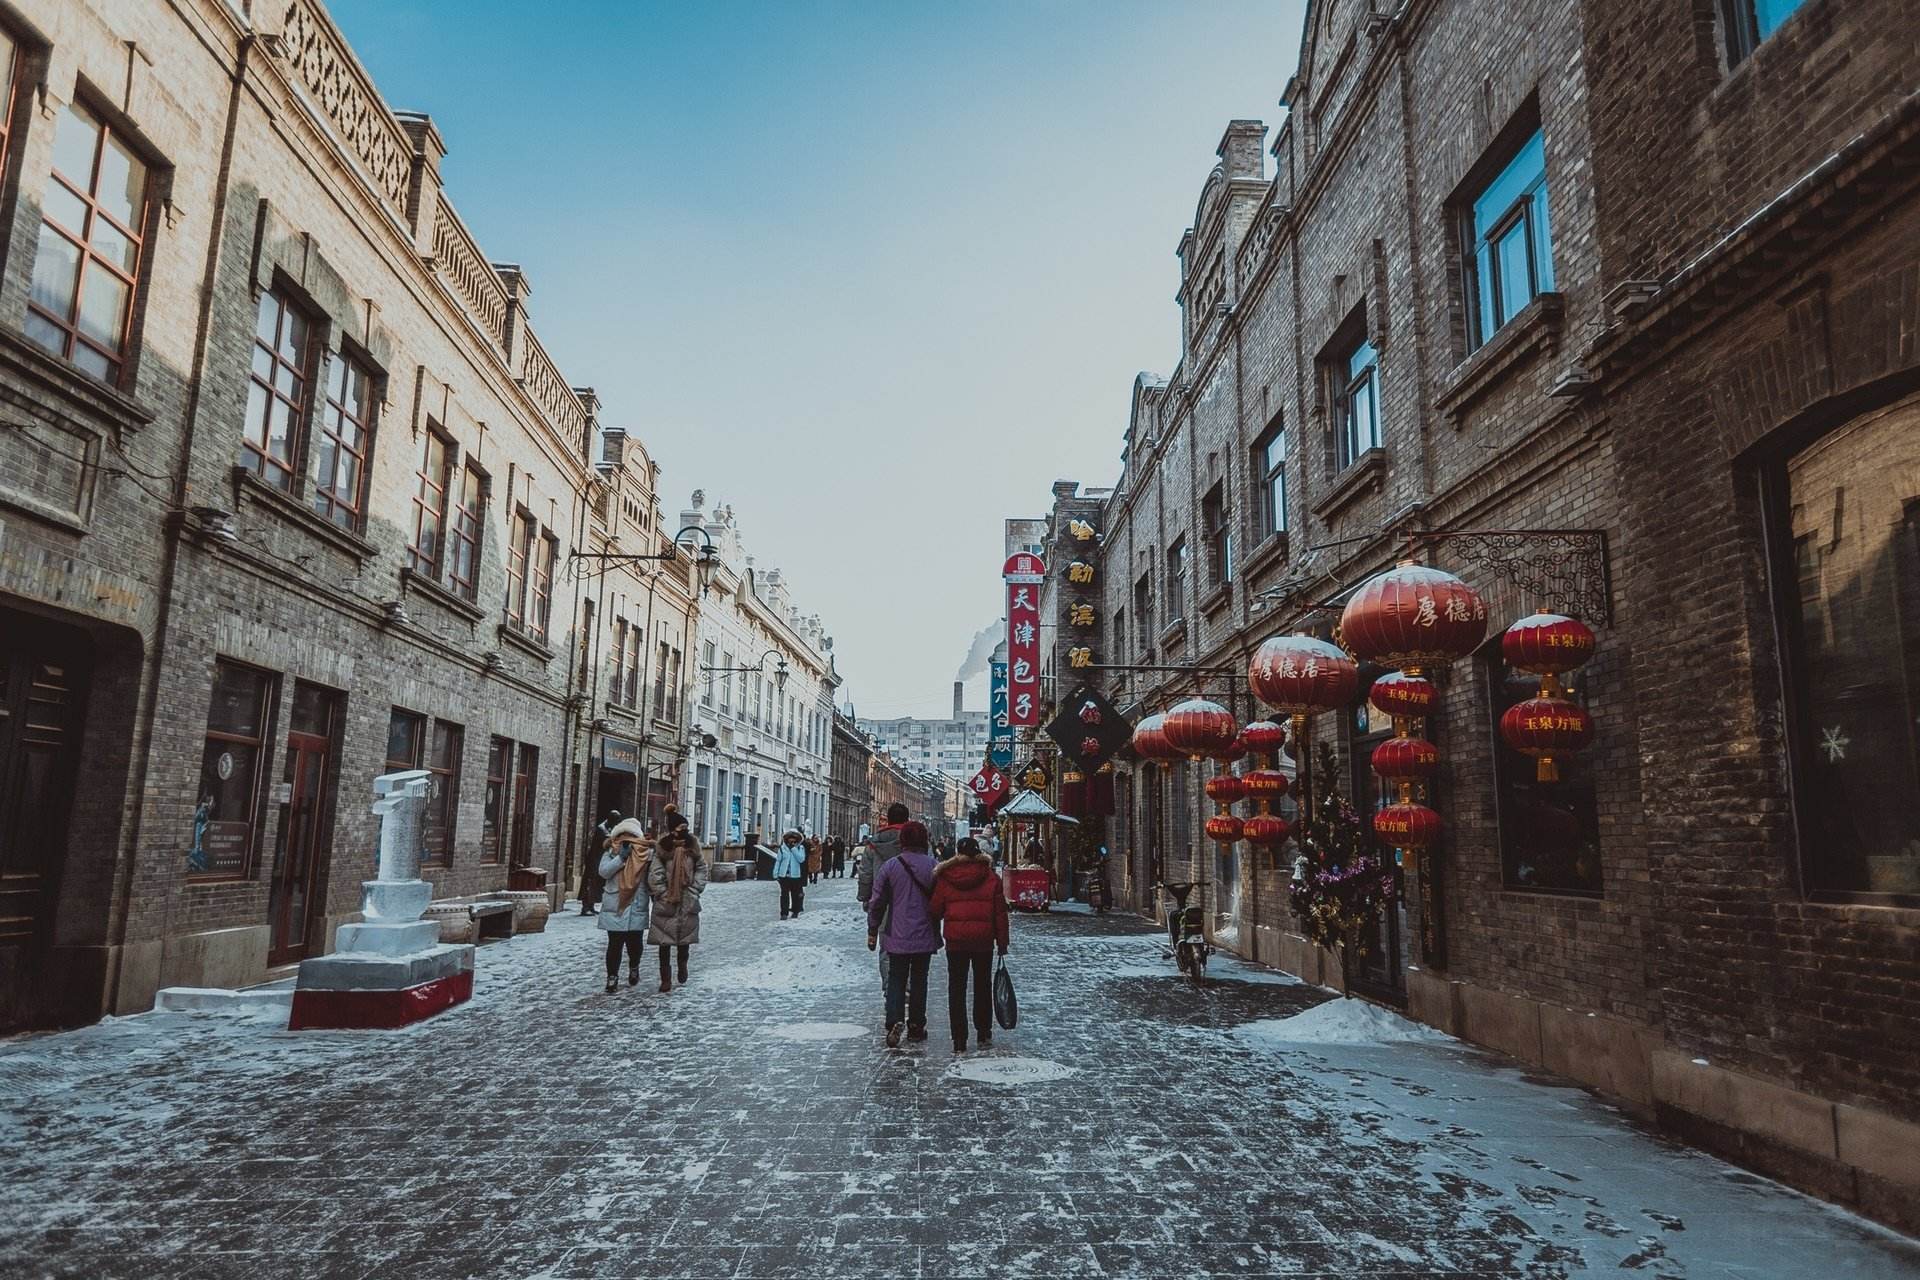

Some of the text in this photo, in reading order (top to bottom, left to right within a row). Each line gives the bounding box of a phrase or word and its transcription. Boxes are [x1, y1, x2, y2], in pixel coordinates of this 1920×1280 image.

[1412, 596, 1487, 628] 厚德居
[1545, 633, 1591, 648] 玉泉方
[1013, 588, 1036, 720] 天津包子
[1524, 716, 1585, 732] 玉泉方瓶
[975, 771, 1003, 793] 包子
